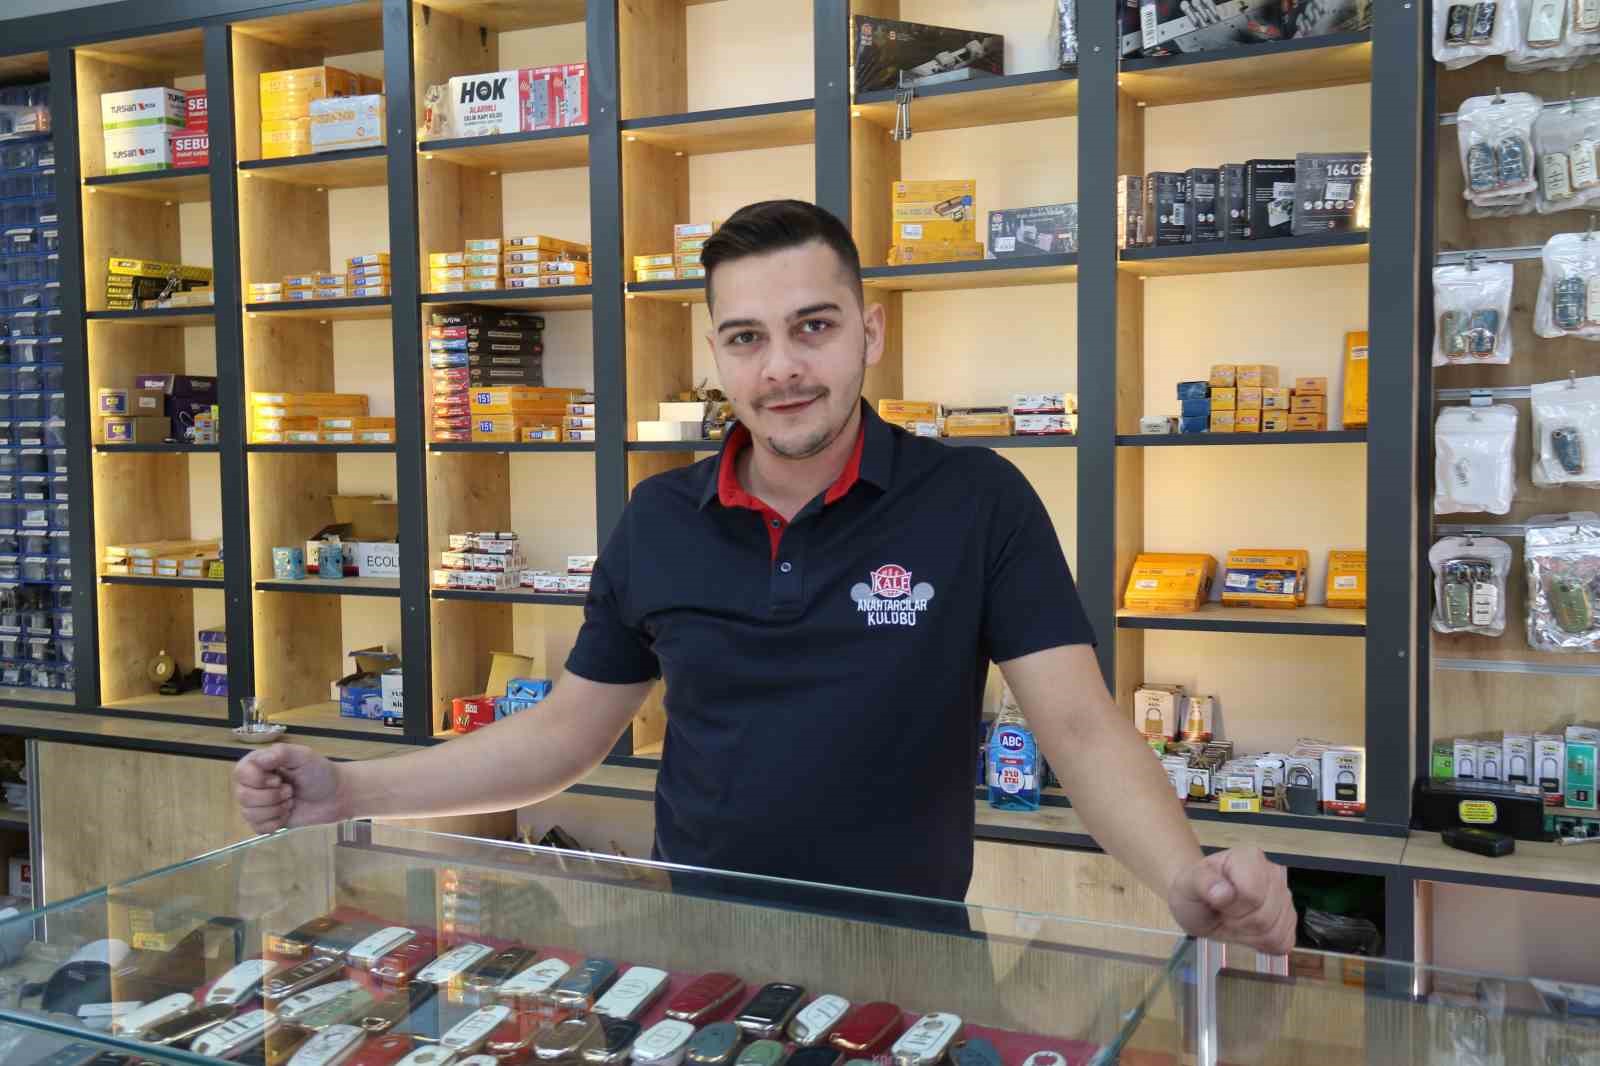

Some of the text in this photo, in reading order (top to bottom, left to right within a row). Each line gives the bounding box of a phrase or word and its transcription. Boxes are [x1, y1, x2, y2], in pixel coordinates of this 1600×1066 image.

[460, 78, 507, 103] HOK
[1326, 163, 1348, 177] 164
[478, 393, 491, 404] 151
[480, 421, 492, 432] 151
[367, 555, 399, 568] ECOL
[874, 576, 910, 592] KALE
[857, 600, 927, 612] ANAHTARCILAR
[1002, 736, 1022, 747] ABC
